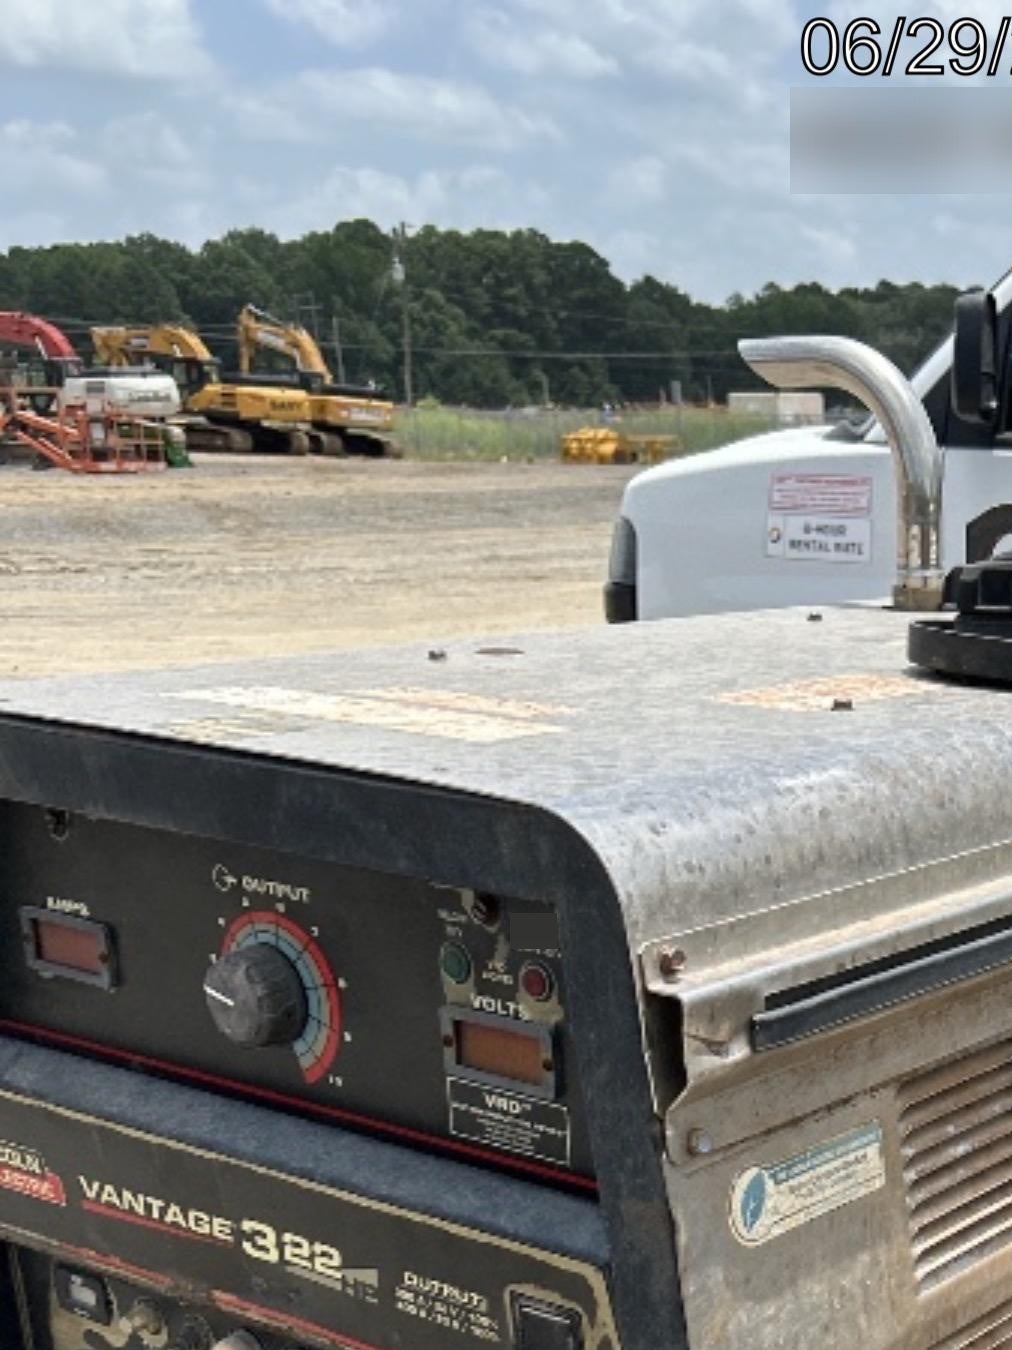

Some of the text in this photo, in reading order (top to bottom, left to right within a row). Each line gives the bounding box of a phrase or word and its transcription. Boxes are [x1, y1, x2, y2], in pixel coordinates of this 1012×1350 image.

[788, 540, 832, 553] RENTAL
[242, 875, 310, 902] OUTPUT
[79, 1175, 235, 1240] VANTAGE
[240, 1220, 344, 1280] 322
